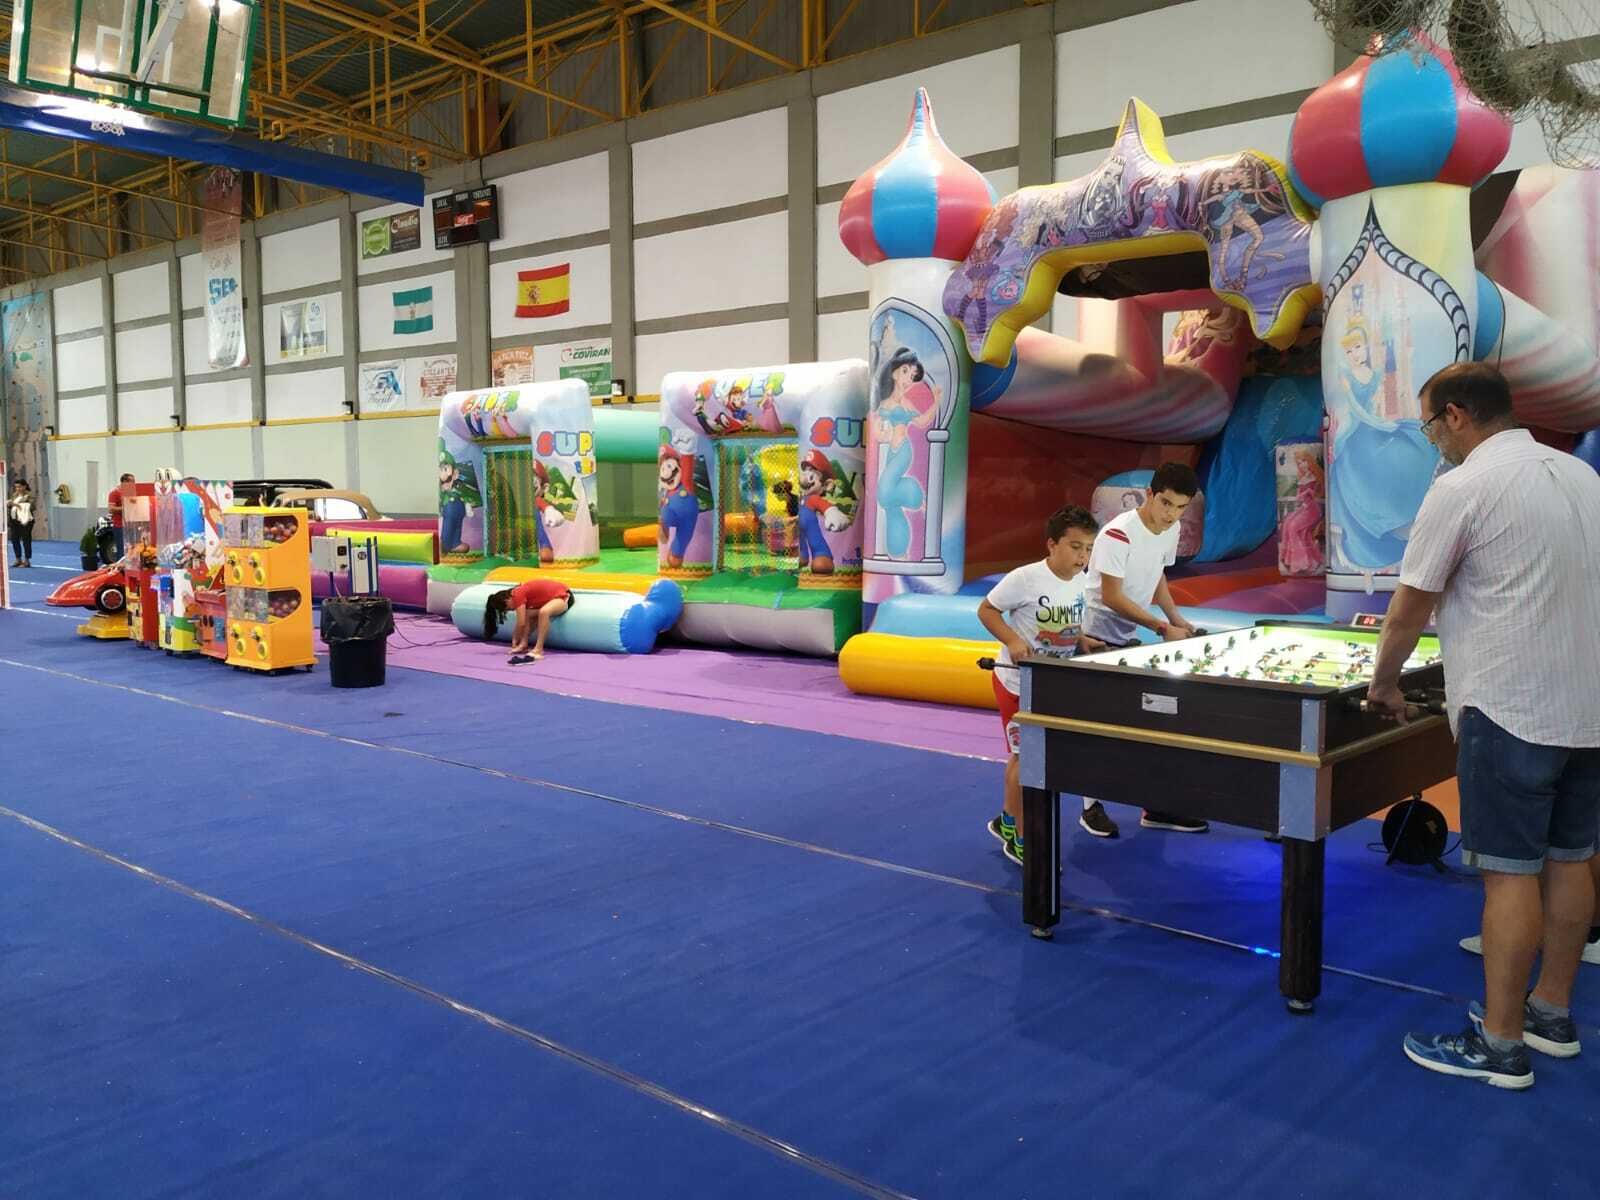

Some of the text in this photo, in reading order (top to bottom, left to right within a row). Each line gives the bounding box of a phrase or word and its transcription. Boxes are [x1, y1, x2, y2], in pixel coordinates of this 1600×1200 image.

[573, 348, 611, 361] COVIRAN
[809, 416, 867, 449] SU
[1035, 595, 1083, 625] SUMMER
